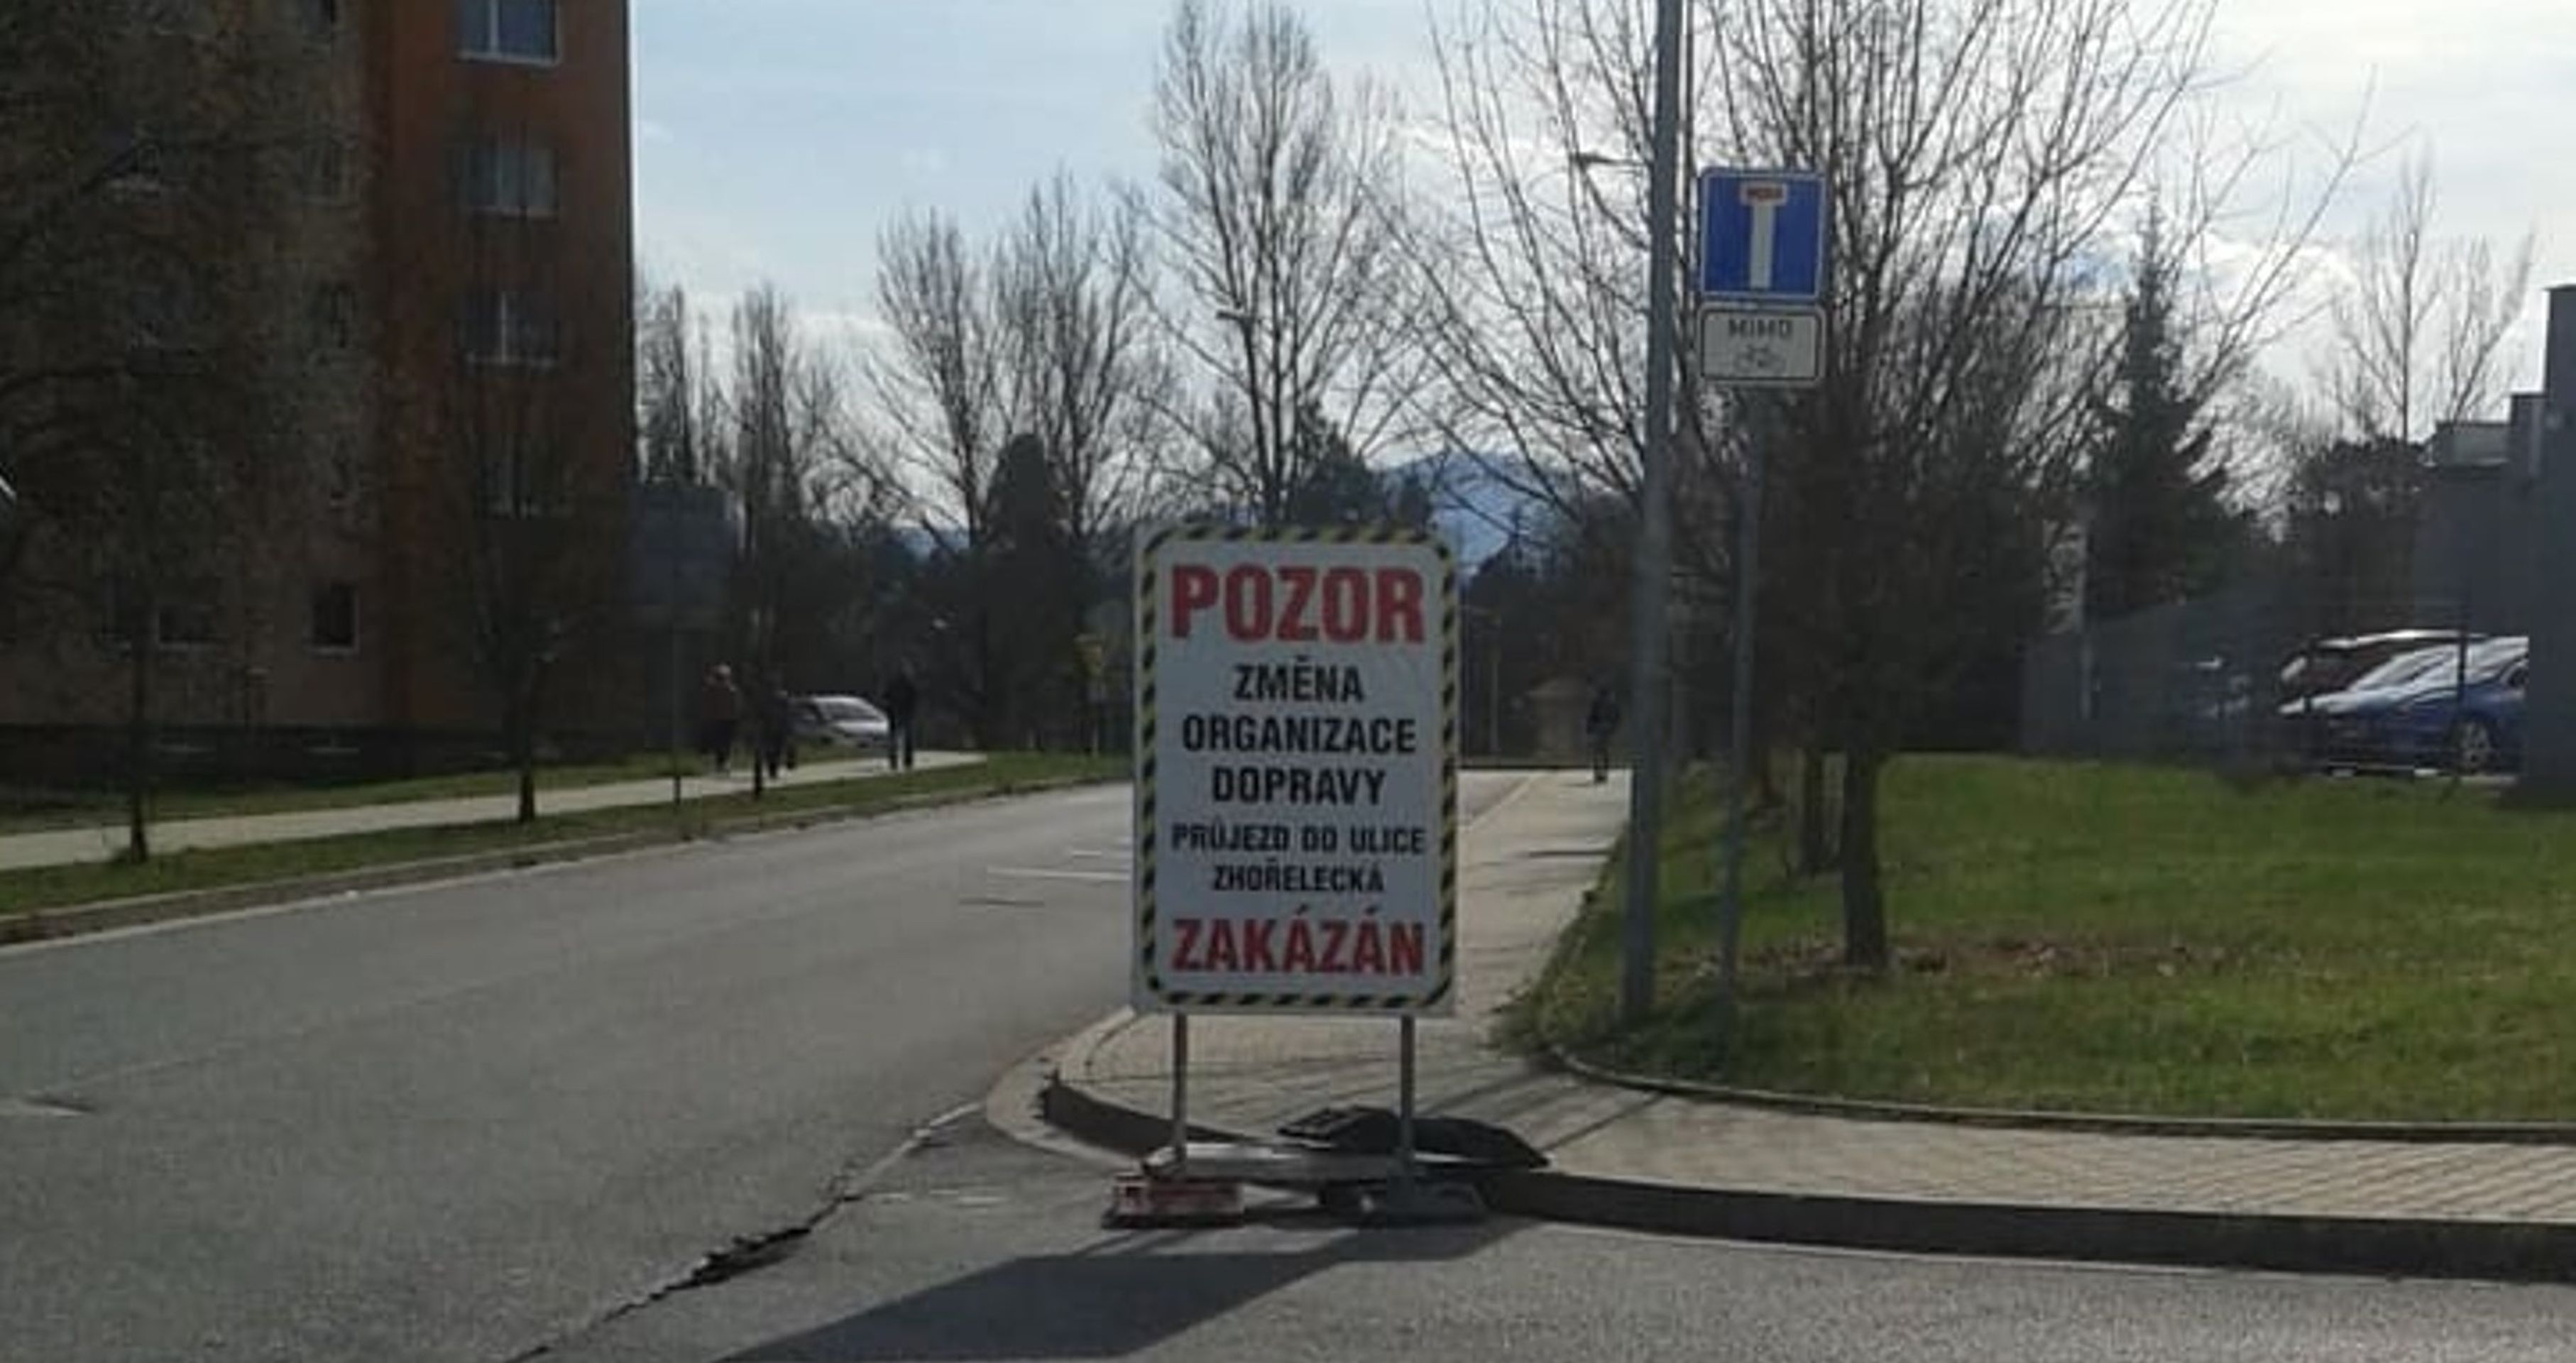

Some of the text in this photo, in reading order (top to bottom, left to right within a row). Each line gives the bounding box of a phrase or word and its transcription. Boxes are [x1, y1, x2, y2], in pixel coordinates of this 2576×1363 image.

[1729, 318, 1792, 339] MIMO
[1171, 562, 1425, 644] POZOR
[1233, 654, 1364, 703] ZMĚNA
[1181, 713, 1416, 753] ORGANIZACE
[1212, 767, 1386, 806] DOPRAVY
[1171, 816, 1426, 854] PRŮJEZD DO ULICE
[1212, 857, 1384, 892] ZHOŘELECKÁ
[1171, 904, 1425, 975] ZAKÁZÁN
